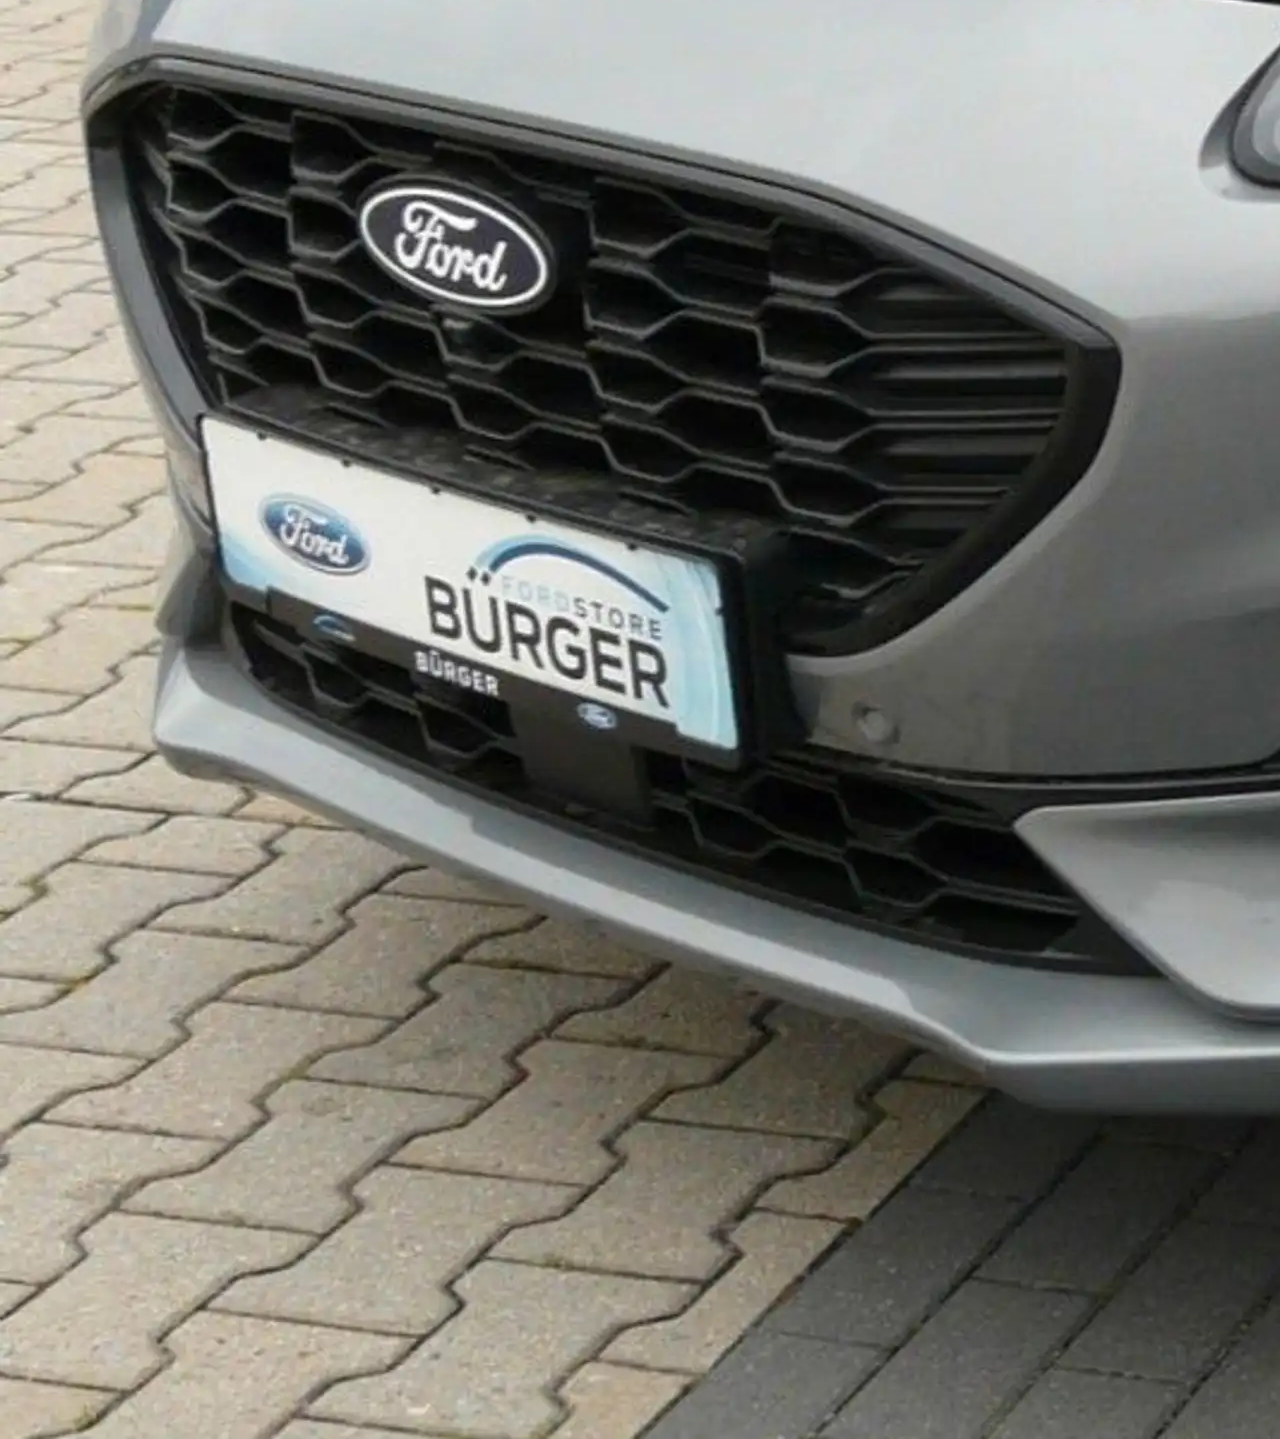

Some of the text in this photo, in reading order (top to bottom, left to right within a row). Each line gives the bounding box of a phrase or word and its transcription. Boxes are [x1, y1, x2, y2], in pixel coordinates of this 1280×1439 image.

[394, 200, 508, 292] Ford
[279, 504, 350, 565] Ford
[414, 650, 500, 697] BÜRGER
[424, 566, 670, 709] BÜRGER
